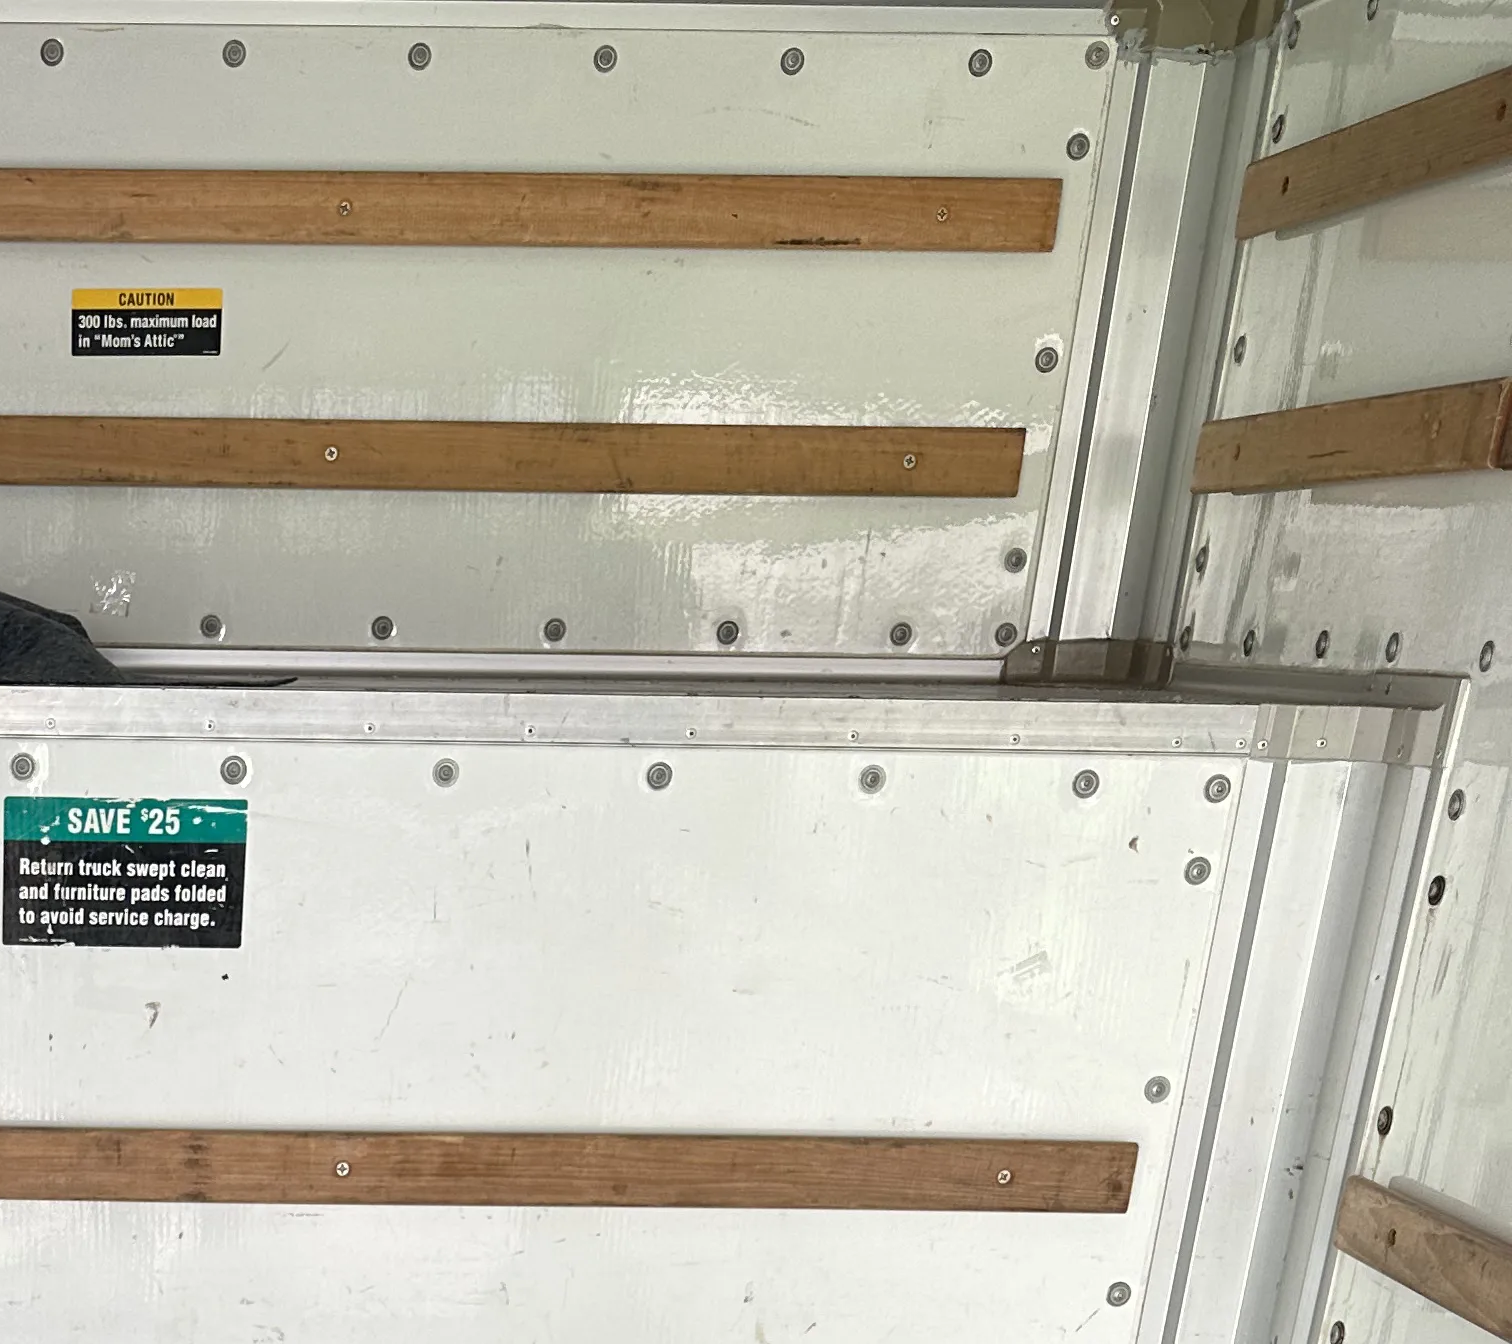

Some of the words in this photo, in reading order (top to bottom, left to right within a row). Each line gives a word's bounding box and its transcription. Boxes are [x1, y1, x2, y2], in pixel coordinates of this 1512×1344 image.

[118, 292, 175, 306] CAUTION
[78, 314, 101, 329] 300
[104, 314, 128, 329] lbs.
[130, 314, 189, 329] maximum
[191, 314, 218, 329] load
[78, 334, 91, 348] in
[67, 807, 131, 835] SAVE
[140, 807, 181, 835] $25
[19, 857, 74, 877] Return
[78, 858, 122, 878] truck
[126, 859, 176, 881] swept
[180, 859, 227, 878] clean
[19, 883, 49, 900] and
[53, 883, 126, 901] furniture
[130, 885, 170, 905] pads
[174, 885, 227, 903] folded
[19, 908, 35, 925] to
[39, 907, 85, 925] avoid
[88, 909, 149, 926] service
[153, 909, 216, 930] charge.
